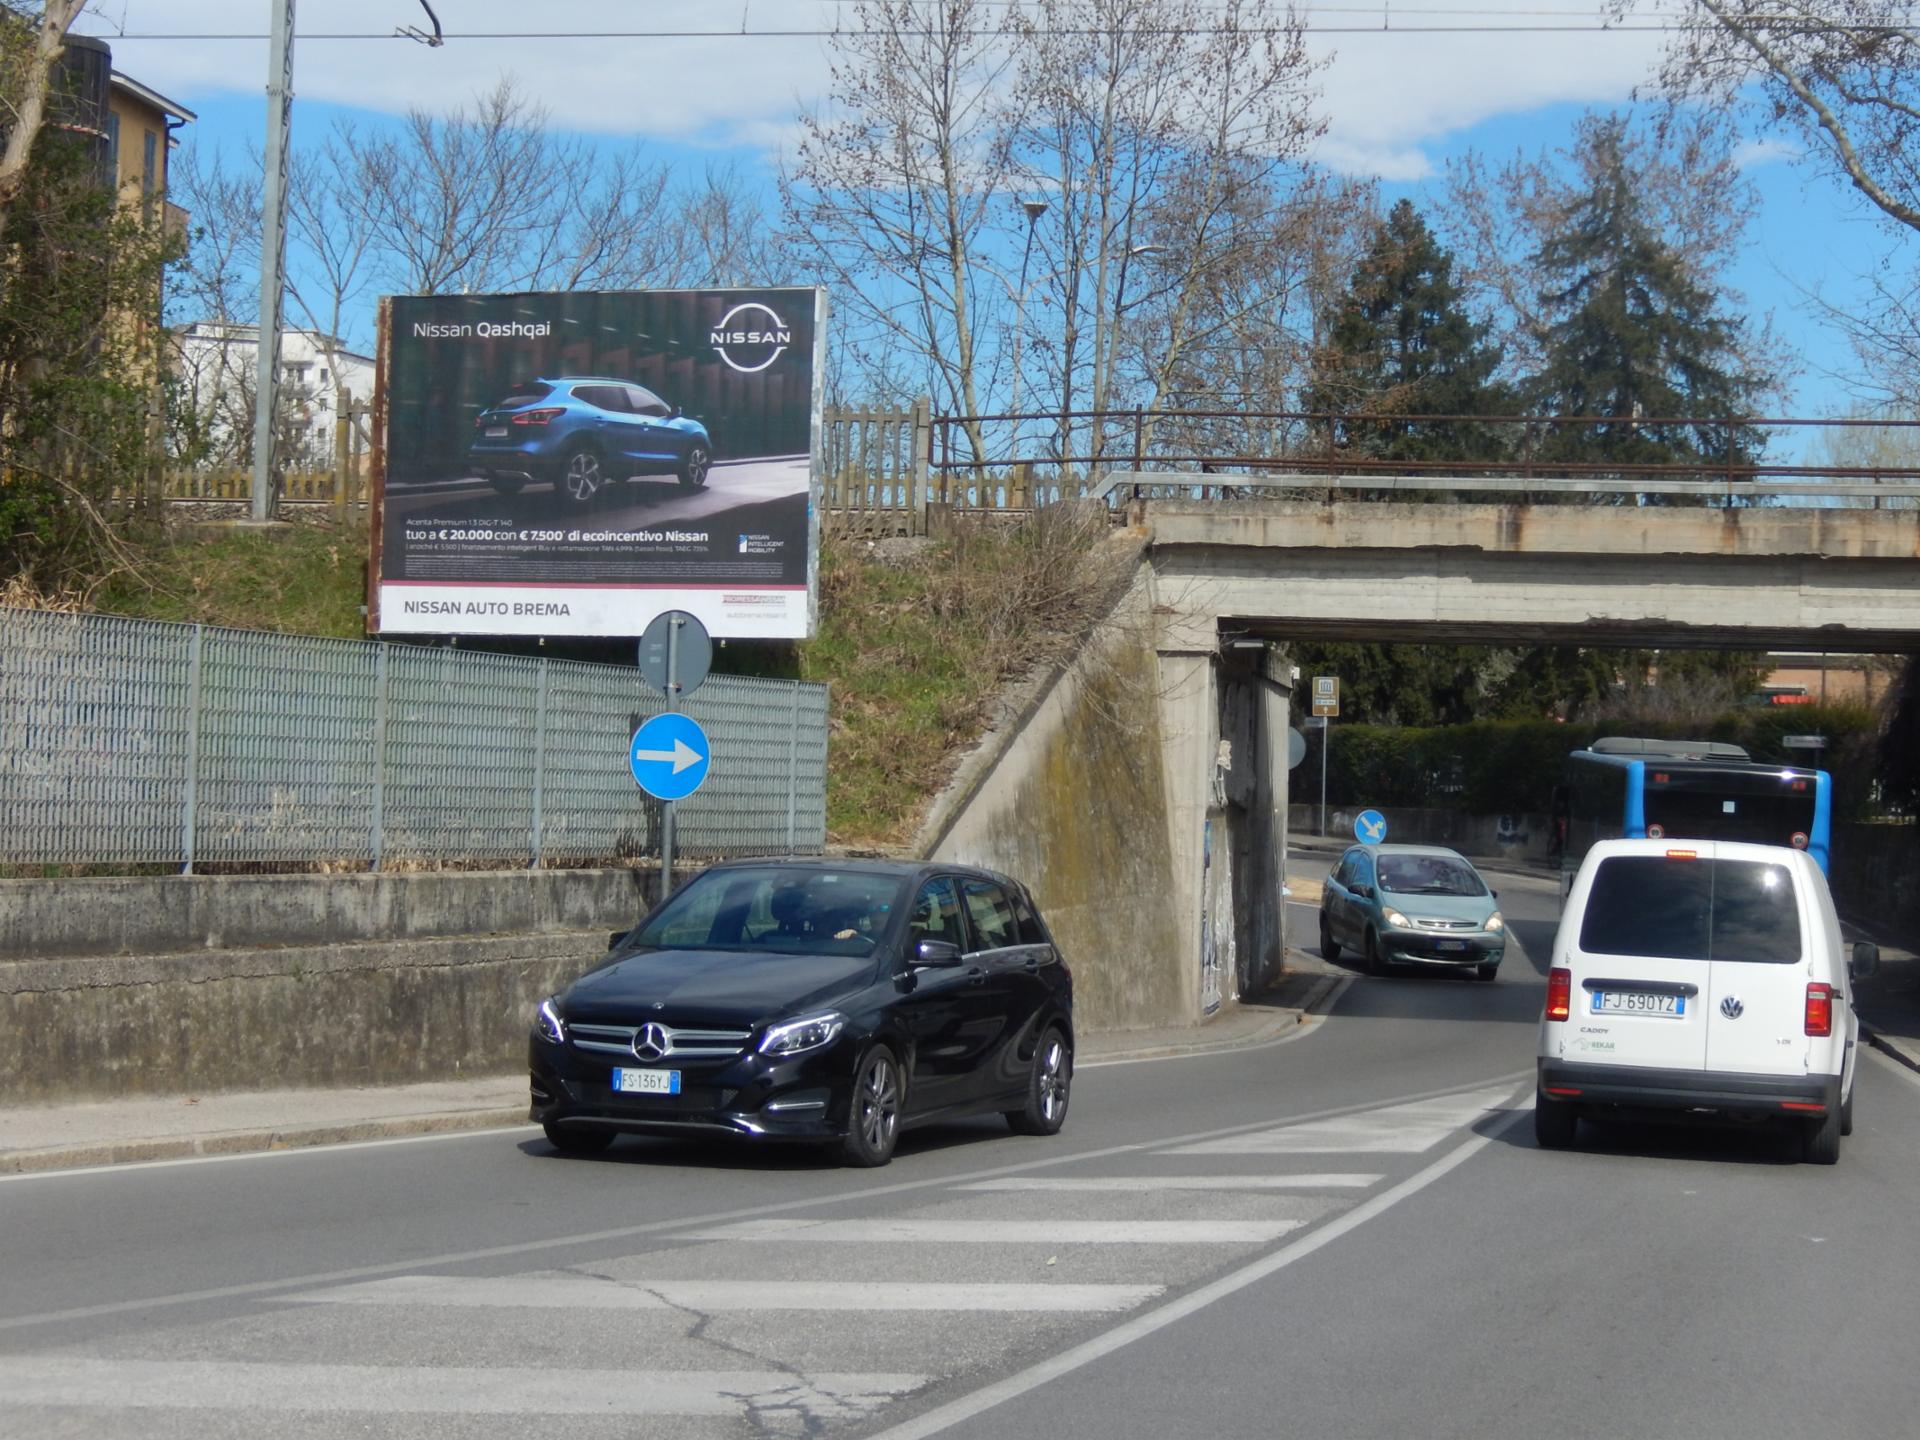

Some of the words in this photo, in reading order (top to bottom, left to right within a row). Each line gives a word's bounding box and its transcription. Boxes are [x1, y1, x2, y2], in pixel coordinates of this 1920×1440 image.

[413, 322, 472, 337] Nissan
[477, 321, 550, 340] Qashqai
[711, 332, 791, 344] NISSAN
[406, 530, 427, 540] tuo
[429, 531, 437, 540] a
[438, 530, 448, 540] €
[450, 530, 493, 540] 20.000
[494, 531, 517, 540] con
[519, 530, 529, 541] €
[568, 530, 580, 541] di
[582, 530, 663, 542] ecoincentivo
[665, 531, 709, 542] Nissan
[404, 600, 461, 614] NISSAN
[465, 602, 509, 615] AUTO
[513, 602, 571, 616] BREMA
